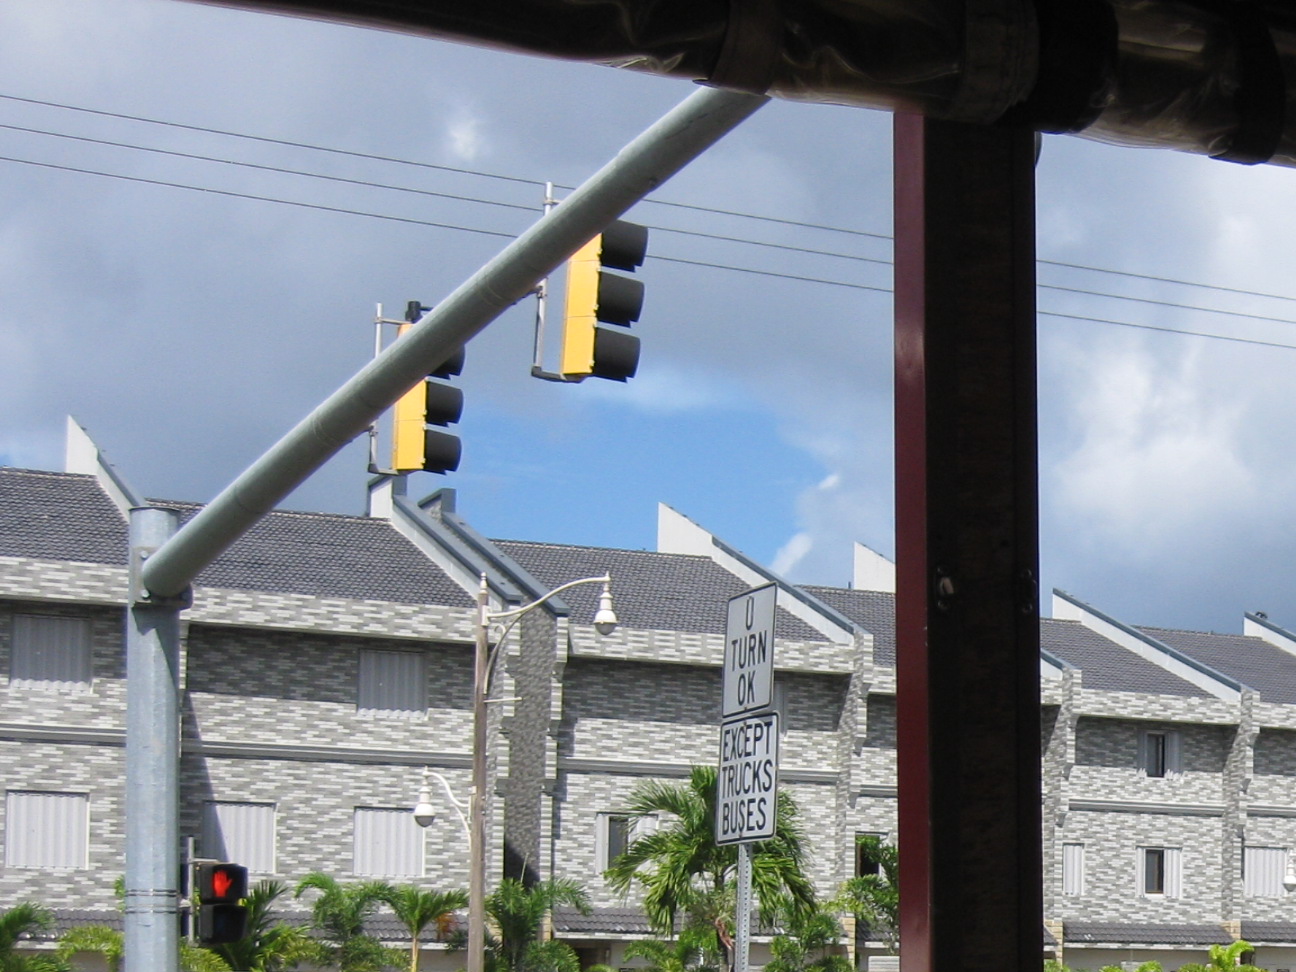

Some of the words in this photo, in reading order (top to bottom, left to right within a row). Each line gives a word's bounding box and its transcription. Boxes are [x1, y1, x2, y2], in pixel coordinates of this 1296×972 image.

[745, 596, 754, 631] U
[731, 630, 767, 672] TURN
[737, 670, 755, 706] OK
[723, 721, 773, 762] EXCEPT
[721, 759, 773, 799] TRUCKS
[722, 797, 767, 835] BUSES
